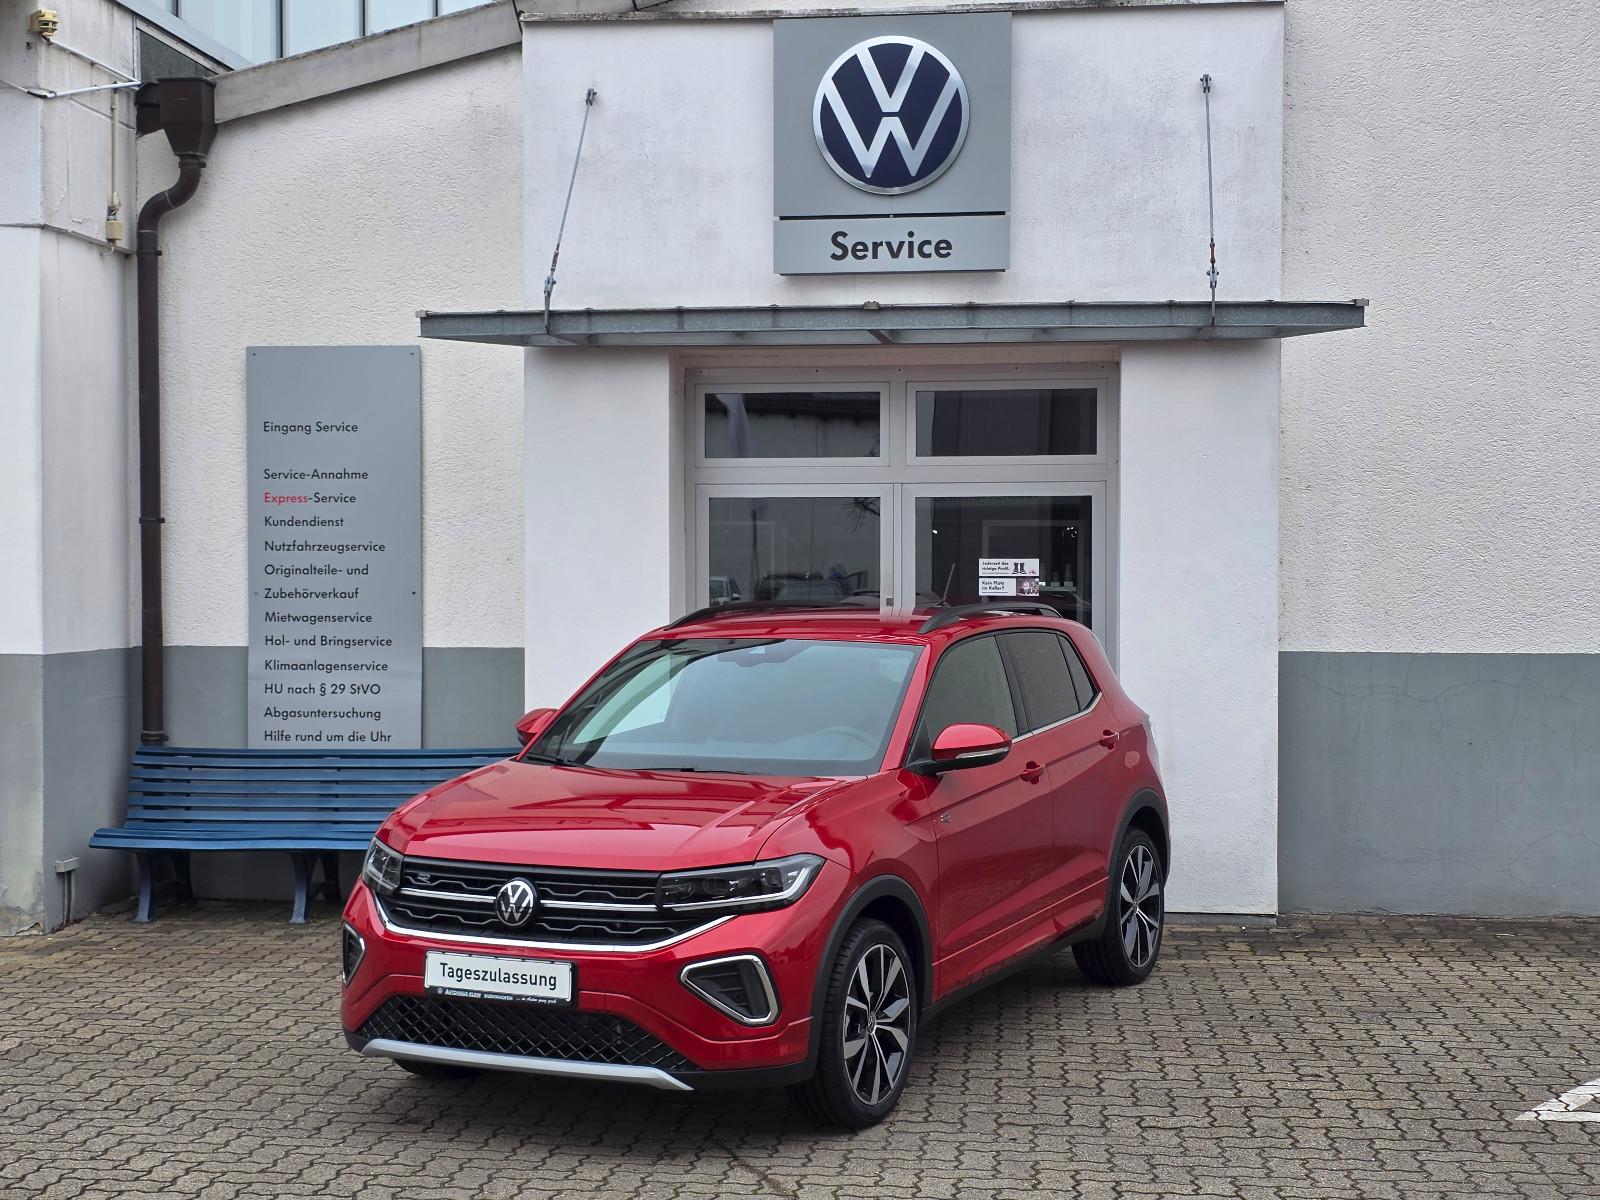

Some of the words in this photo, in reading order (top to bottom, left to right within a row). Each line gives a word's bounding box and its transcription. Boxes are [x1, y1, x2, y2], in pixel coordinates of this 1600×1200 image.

[829, 230, 953, 261] Service
[263, 421, 312, 435] Eingang
[315, 420, 359, 433] Service
[263, 468, 369, 480] Service-Annahme
[264, 492, 357, 506] Express-Service
[264, 515, 344, 527] Kundendienst
[264, 540, 386, 554] Nutzfahrzeugservice
[264, 564, 343, 578] Originalteile-
[346, 564, 369, 575] und
[264, 587, 359, 599] Zubehörverkauf
[264, 611, 373, 625] Mietwagenservice
[265, 635, 290, 646] Hol-
[294, 635, 316, 646] und
[320, 635, 393, 649] Bringservice
[265, 659, 389, 674] Klimaanlagenservice
[264, 683, 283, 695] HU
[287, 683, 316, 695] nach
[319, 683, 327, 696] §
[330, 683, 346, 695] 29
[349, 683, 381, 695] StVO
[263, 706, 381, 721] Abgasuntersuchung
[264, 730, 292, 742] Hilfe
[295, 730, 322, 742] rund
[326, 733, 344, 742] um
[347, 731, 366, 742] die
[370, 731, 392, 742] Uhr
[440, 962, 557, 991] Tageszulassung
